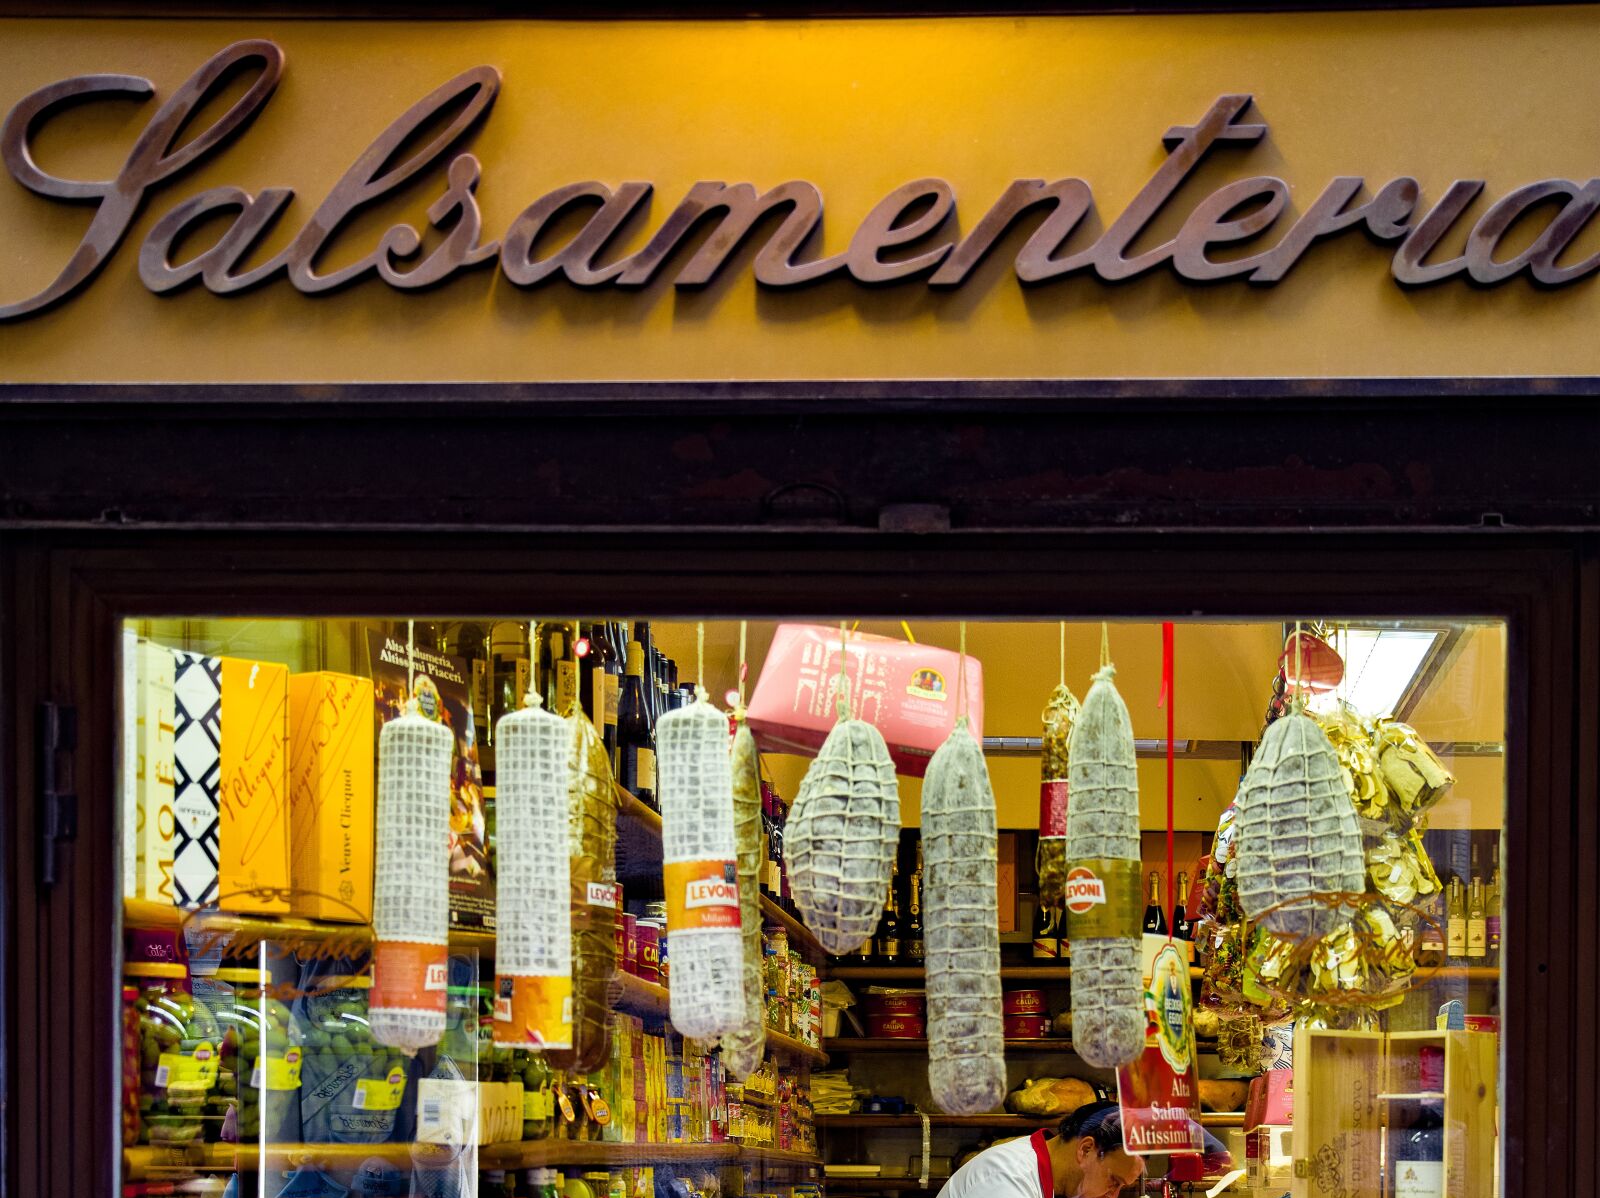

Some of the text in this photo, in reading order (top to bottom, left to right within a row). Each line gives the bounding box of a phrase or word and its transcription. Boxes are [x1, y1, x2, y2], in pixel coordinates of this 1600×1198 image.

[339, 769, 354, 874] Veuve Clicquot
[1171, 1078, 1190, 1097] Alta
[1128, 1124, 1188, 1146] Altissimi
